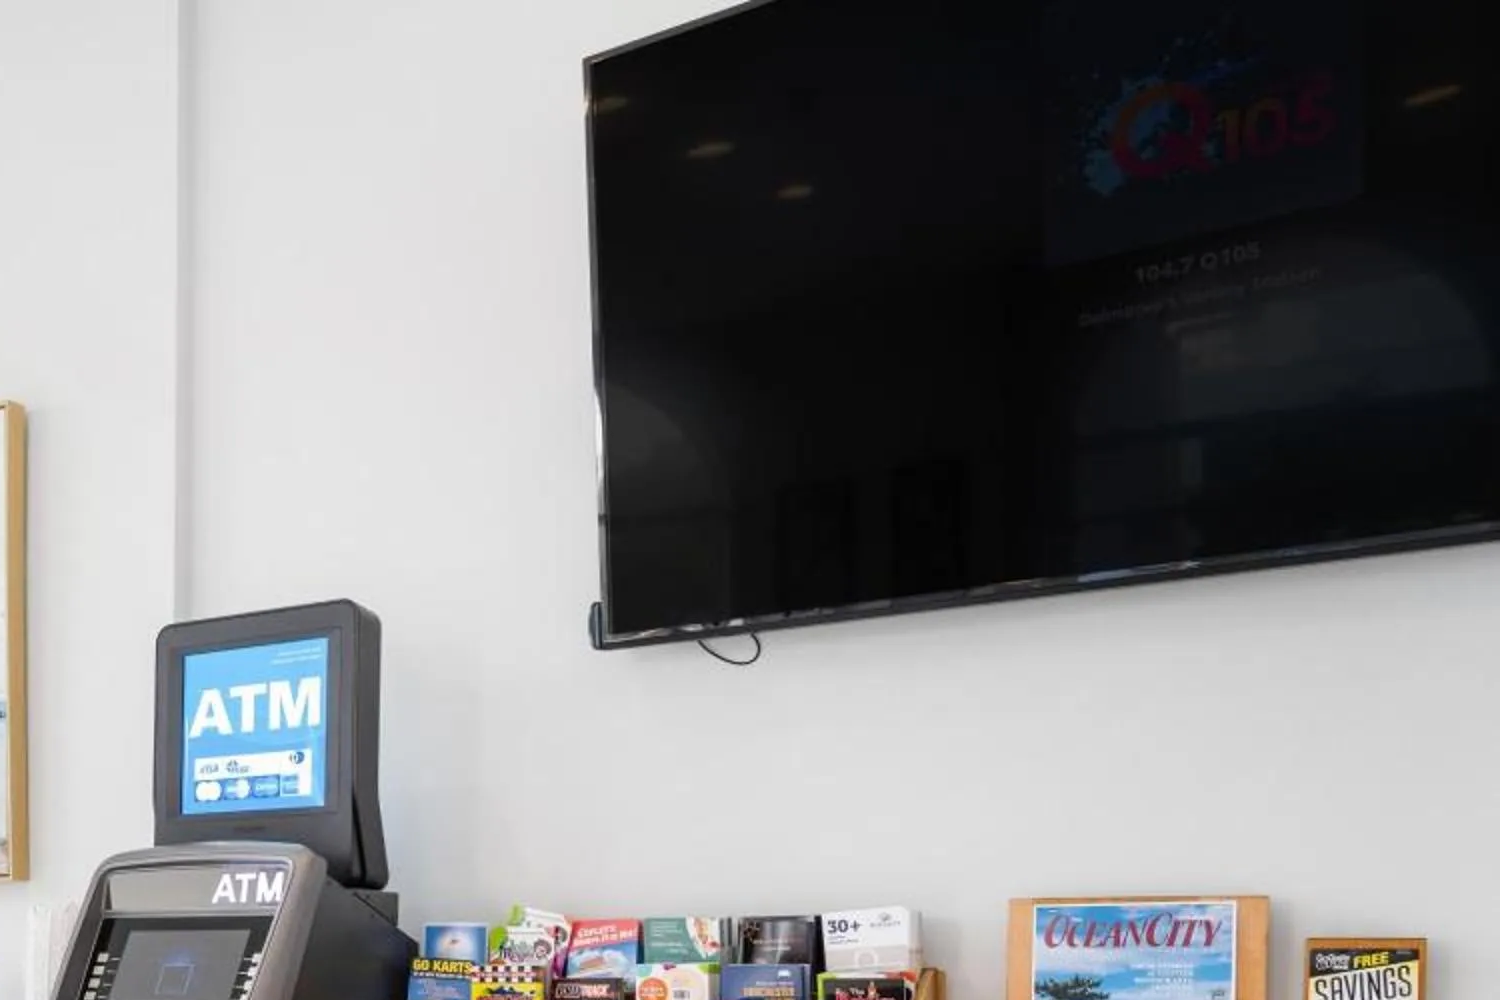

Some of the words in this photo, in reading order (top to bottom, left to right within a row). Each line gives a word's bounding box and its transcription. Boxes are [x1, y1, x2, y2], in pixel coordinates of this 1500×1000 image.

[1135, 256, 1194, 284] 104.7
[1200, 241, 1261, 271] Q105
[188, 676, 321, 739] ATM
[212, 872, 285, 904] ATM
[827, 919, 861, 935] 30+
[413, 959, 429, 971] GO
[434, 960, 472, 974] KARTS
[1354, 952, 1389, 968] FREE
